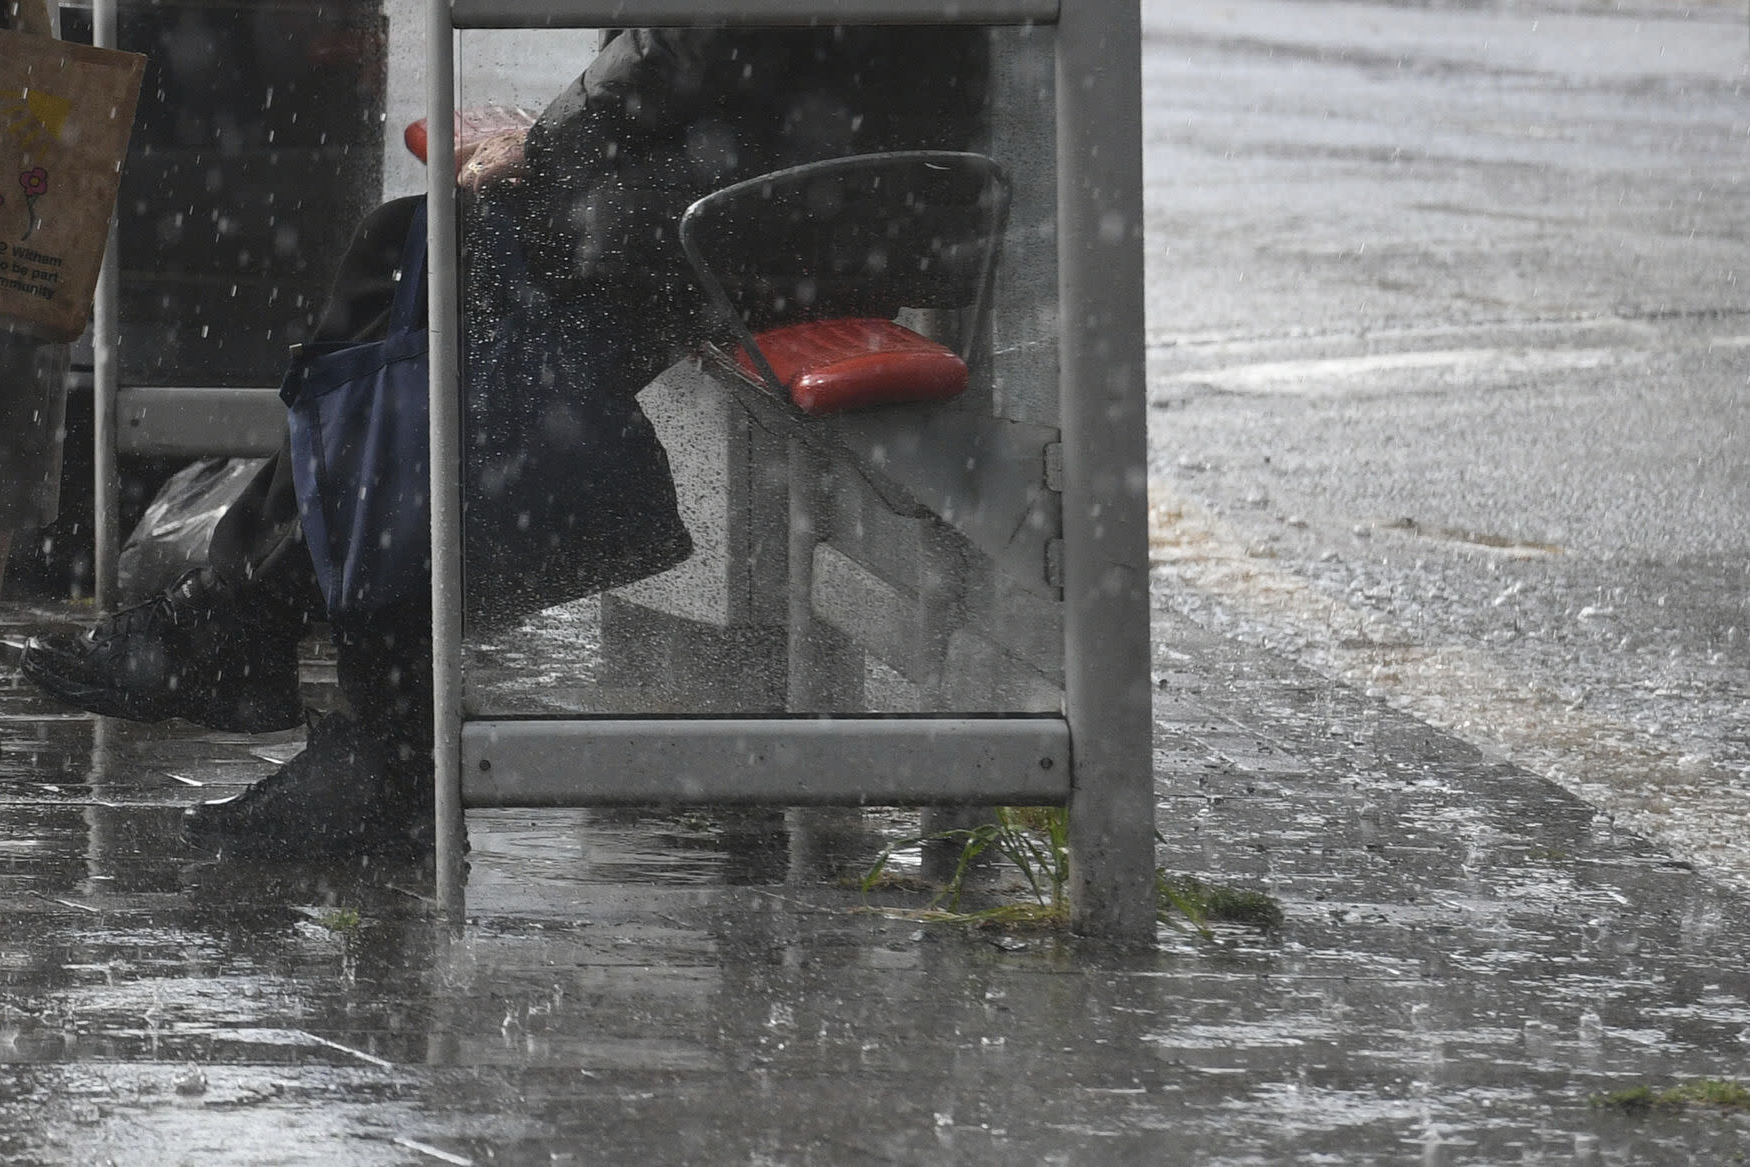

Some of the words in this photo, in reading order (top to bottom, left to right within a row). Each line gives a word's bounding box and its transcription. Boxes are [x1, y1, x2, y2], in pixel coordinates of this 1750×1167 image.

[12, 245, 62, 267] Witham
[12, 262, 28, 275] be
[31, 269, 59, 283] part
